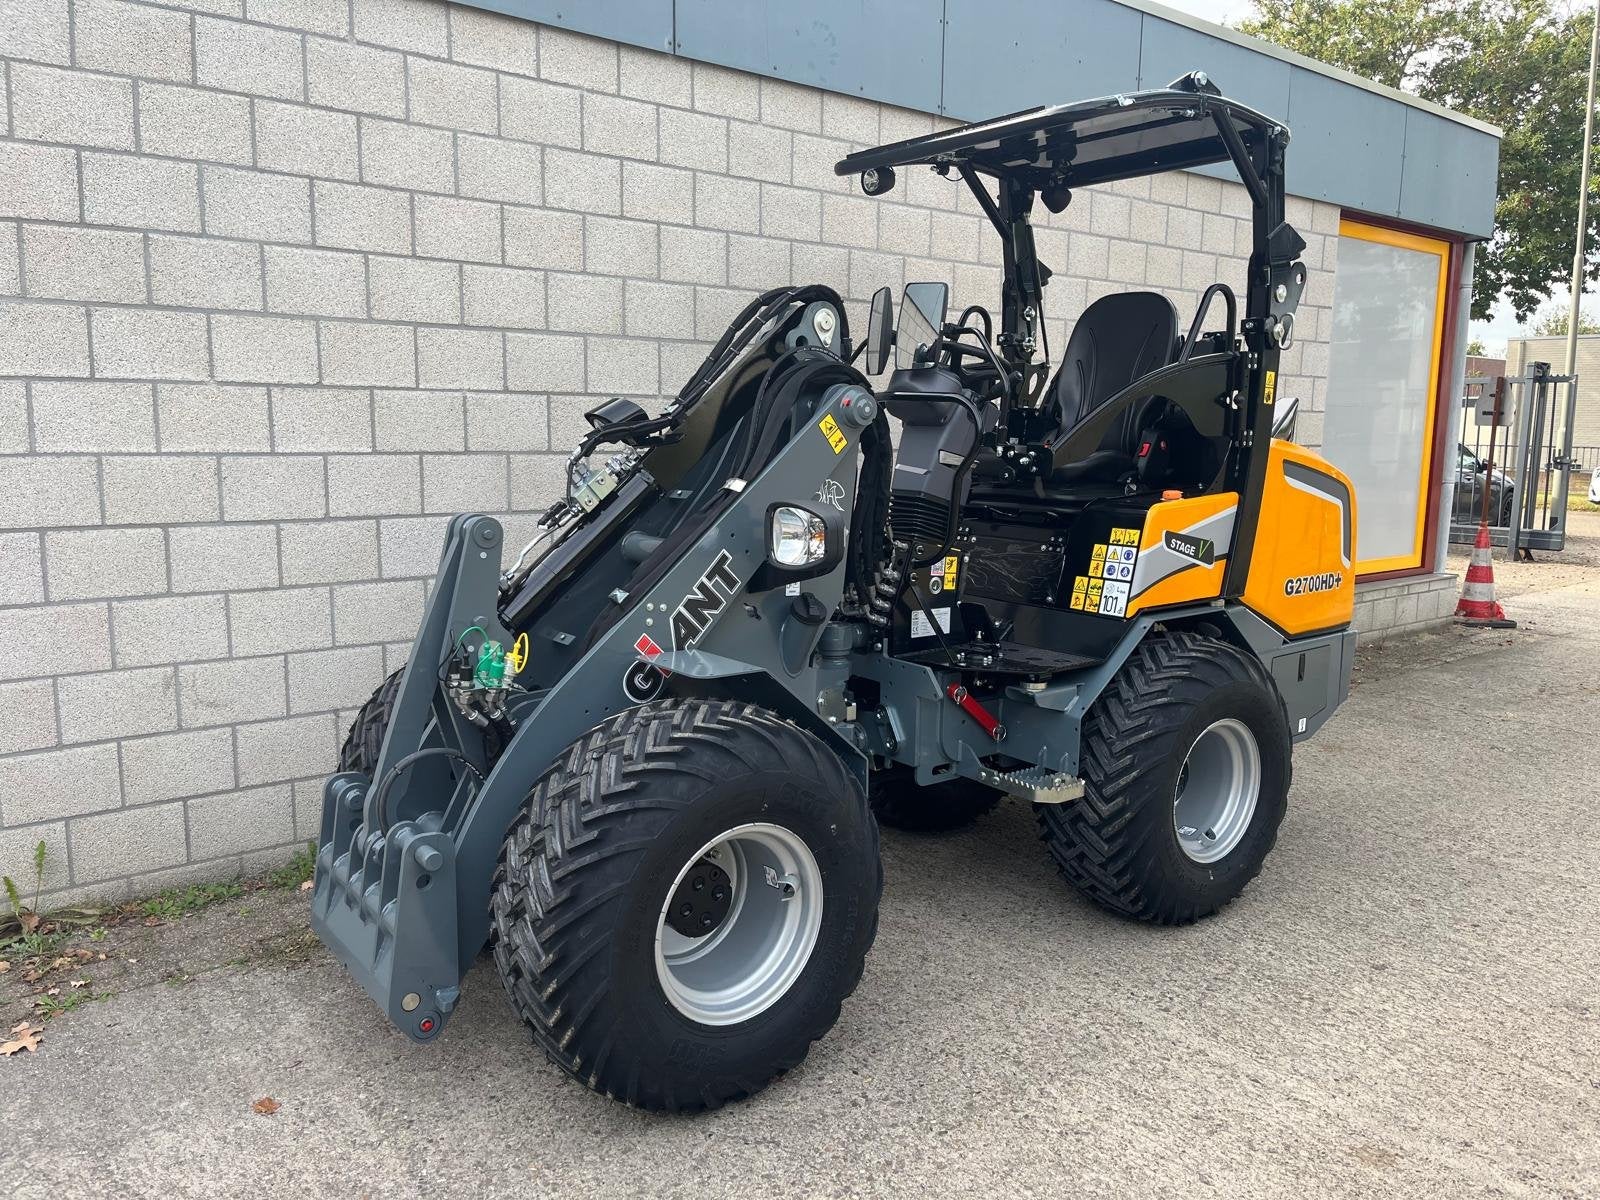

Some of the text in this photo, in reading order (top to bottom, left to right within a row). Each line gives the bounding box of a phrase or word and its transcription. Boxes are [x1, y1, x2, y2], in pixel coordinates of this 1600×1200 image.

[1170, 539, 1196, 556] STAGE
[1284, 571, 1342, 596] G2700HD+
[1102, 594, 1119, 613] 101
